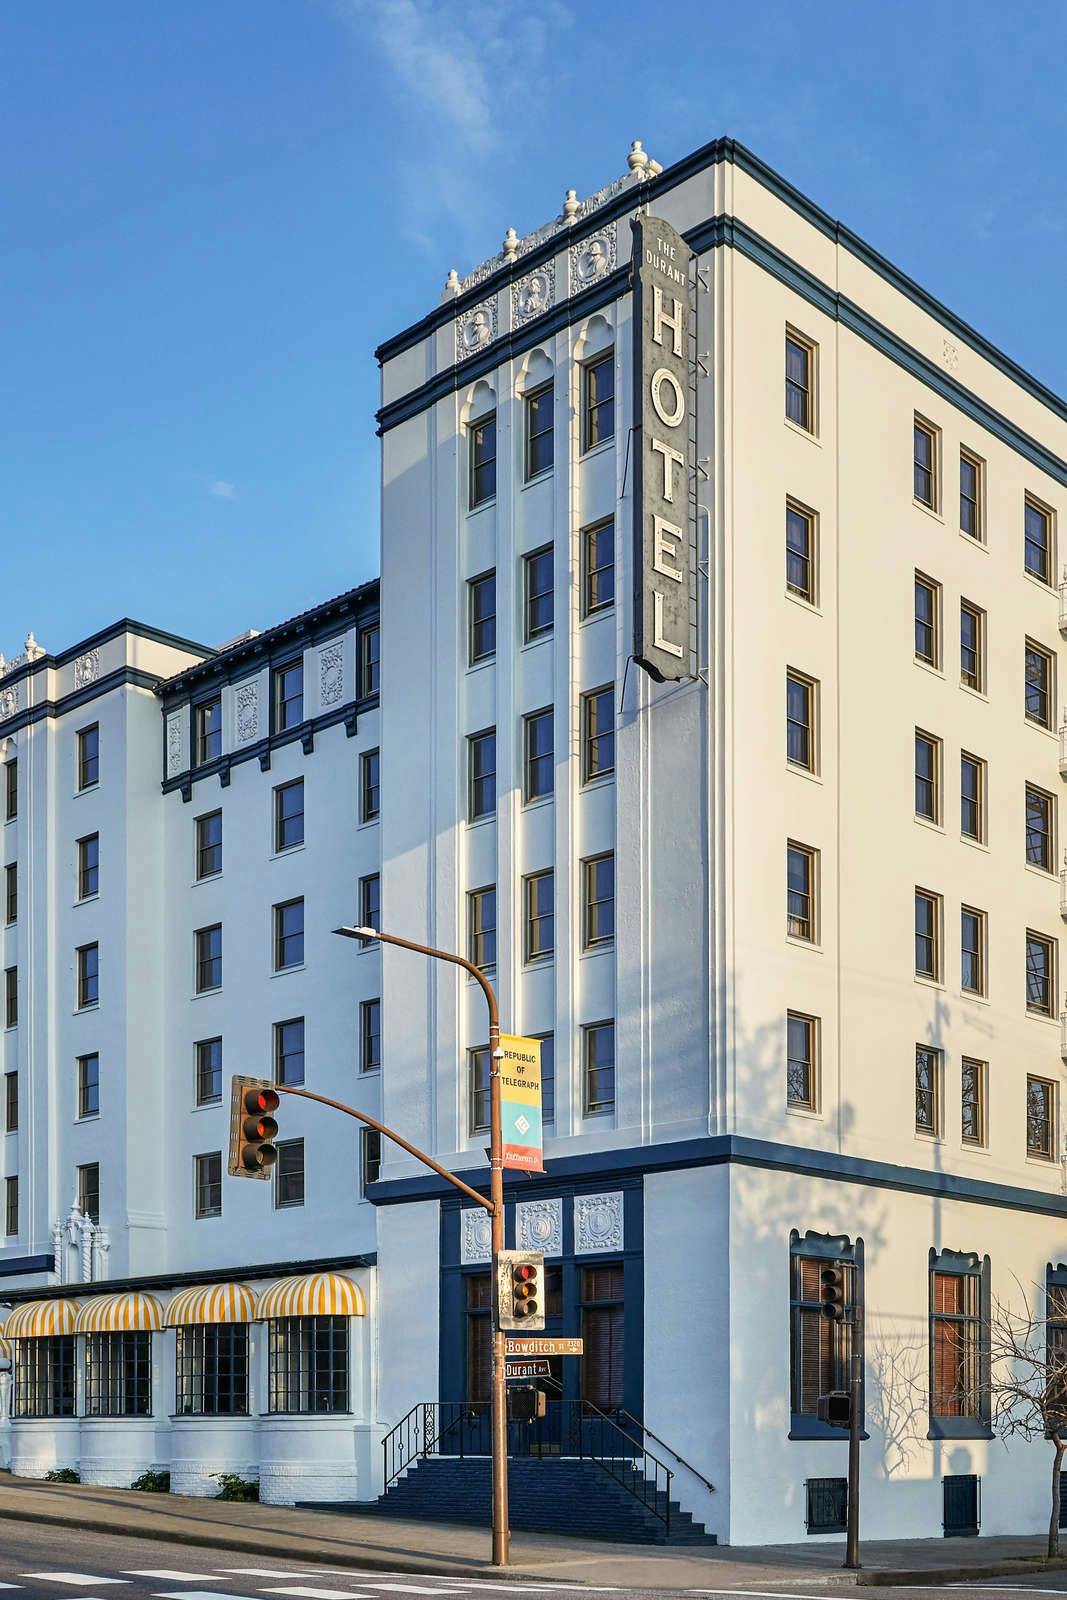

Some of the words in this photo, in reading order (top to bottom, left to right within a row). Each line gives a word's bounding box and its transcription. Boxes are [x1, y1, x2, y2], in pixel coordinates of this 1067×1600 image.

[657, 238, 676, 261] THE
[646, 249, 686, 286] DURANT
[651, 285, 684, 658] HOTEL
[504, 1050, 536, 1063] REPUBLIC
[516, 1065, 525, 1075] OF
[502, 1077, 539, 1090] TELEGRAPH
[508, 1340, 555, 1352] Bowditch
[507, 1363, 537, 1376] Durant
